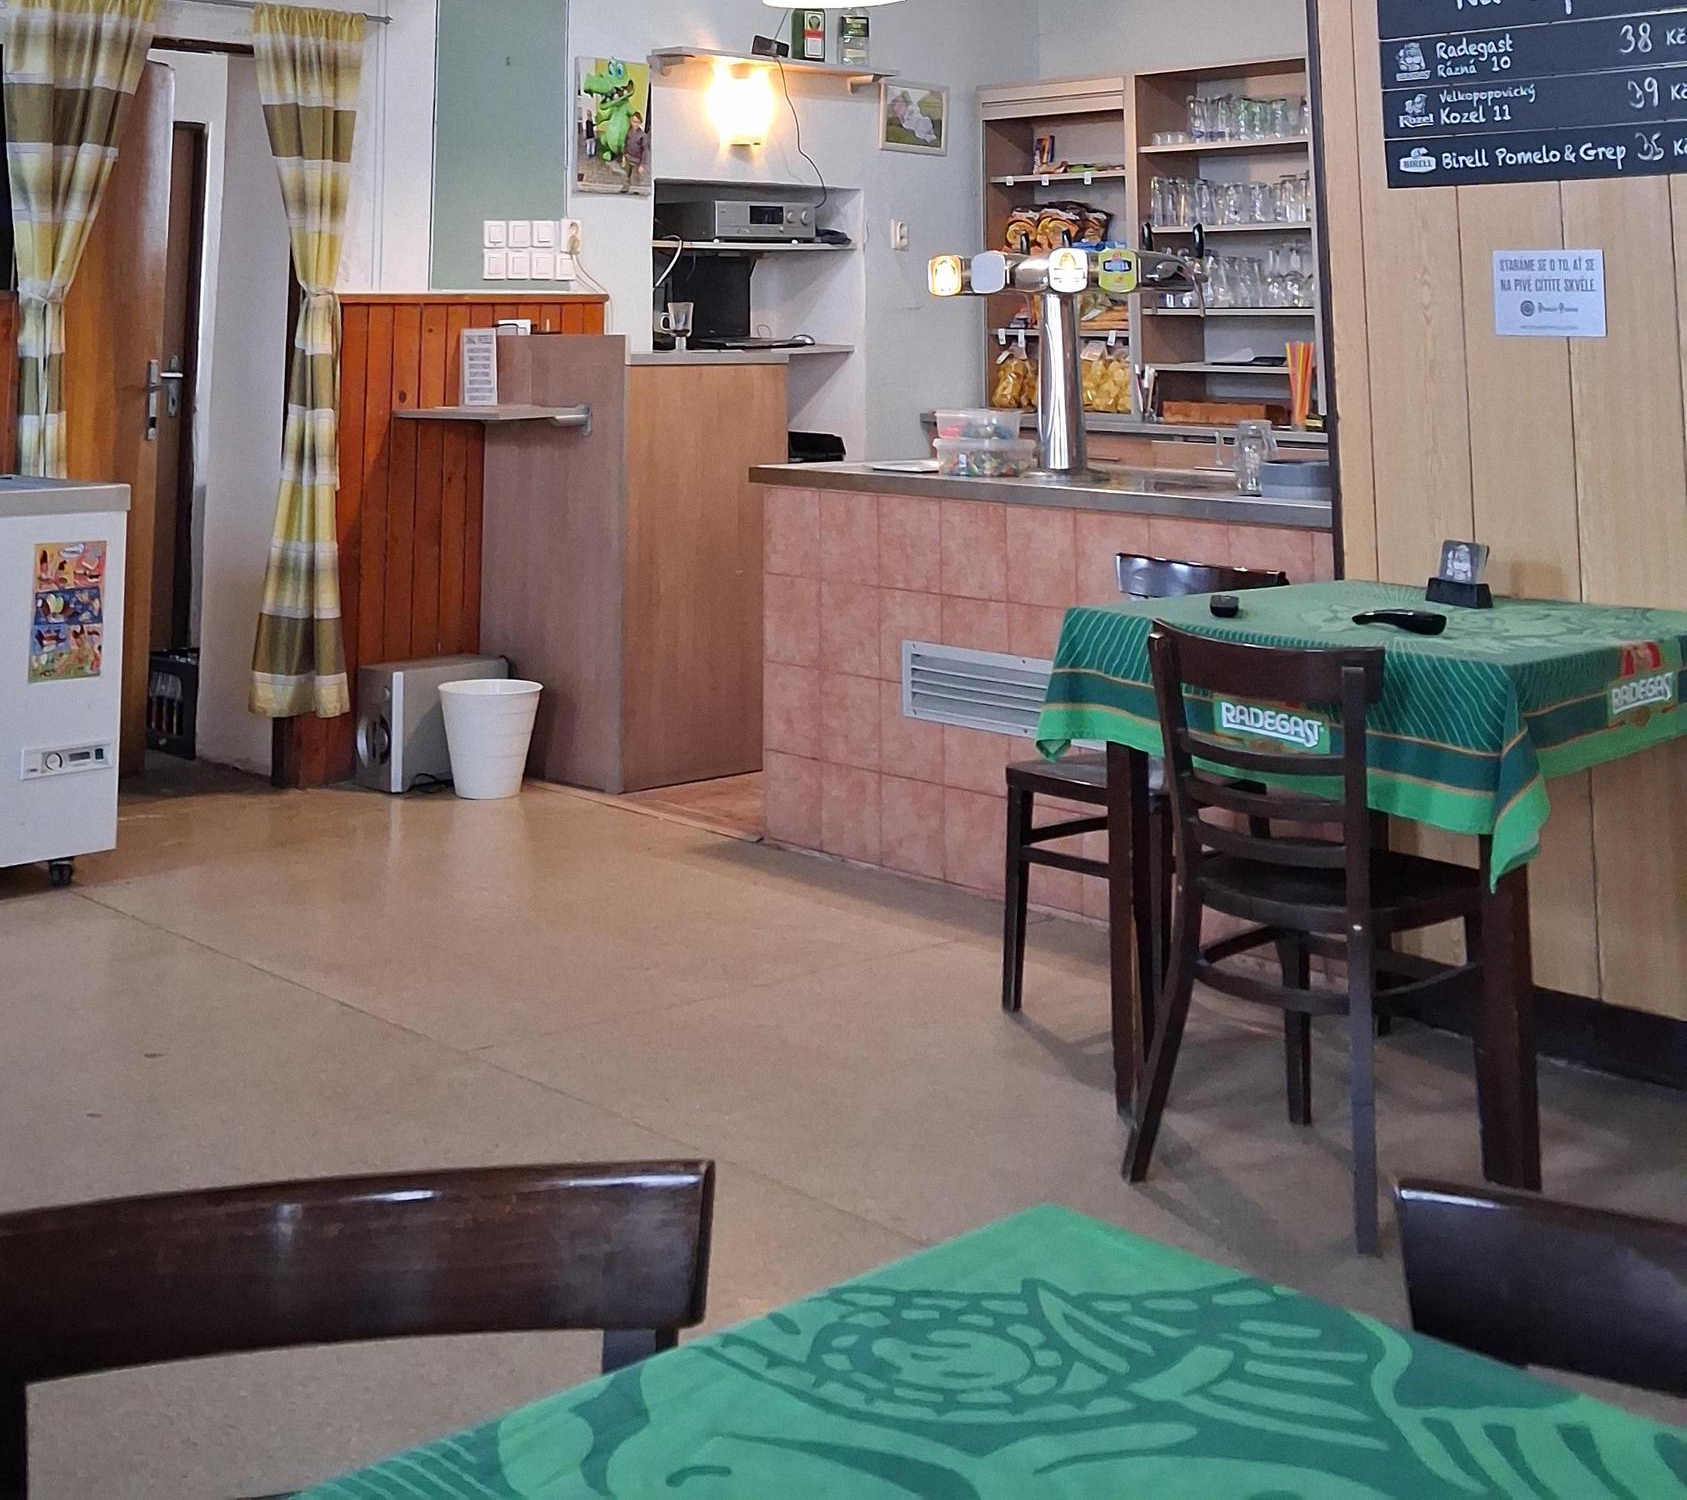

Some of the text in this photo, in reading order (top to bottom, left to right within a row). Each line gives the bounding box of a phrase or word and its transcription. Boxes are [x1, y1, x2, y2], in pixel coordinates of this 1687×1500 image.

[1436, 22, 1687, 61] Radegast 38 Kč
[1437, 59, 1478, 78] Rázná
[1491, 56, 1512, 72] 10
[1439, 84, 1537, 106] Velkopopovický
[1627, 77, 1659, 108] 39
[1399, 114, 1435, 128] Kozel
[1440, 105, 1512, 125] Kozel 11
[1441, 148, 1490, 169] Birell
[1495, 145, 1561, 166] Pomelo
[1564, 144, 1576, 163] &
[1579, 142, 1626, 170] Grep
[1635, 132, 1665, 161] 35
[1538, 258, 1547, 271] SE
[1549, 258, 1556, 271] O
[1585, 258, 1595, 271] SE
[1500, 278, 1511, 292] NA
[1221, 701, 1323, 747] RADEGAST
